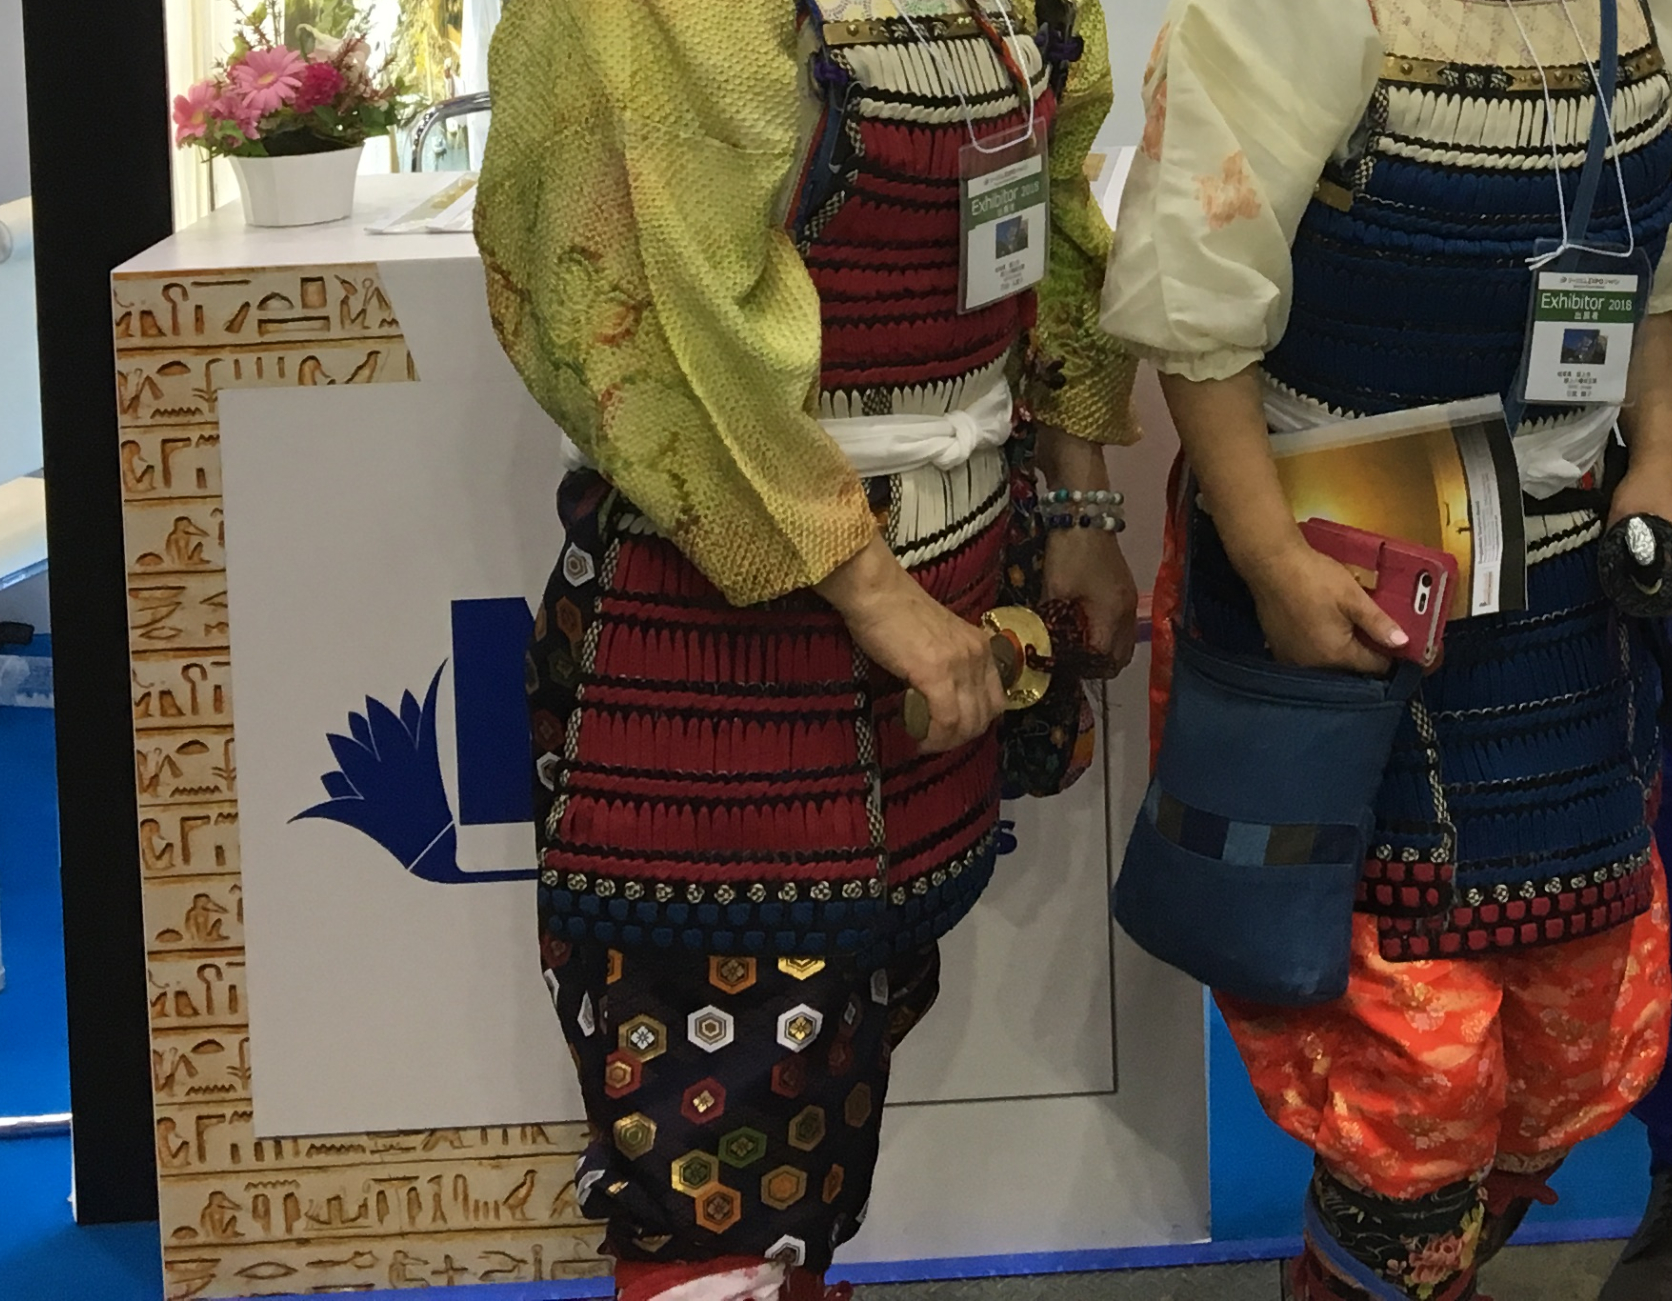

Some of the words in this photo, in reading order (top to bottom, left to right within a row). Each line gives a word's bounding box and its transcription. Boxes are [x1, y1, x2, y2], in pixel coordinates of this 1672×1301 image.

[972, 187, 1018, 216] Exhibitor
[1021, 181, 1040, 197] 2018
[1541, 293, 1605, 310] Exhibitor
[1608, 299, 1632, 311] 2018
